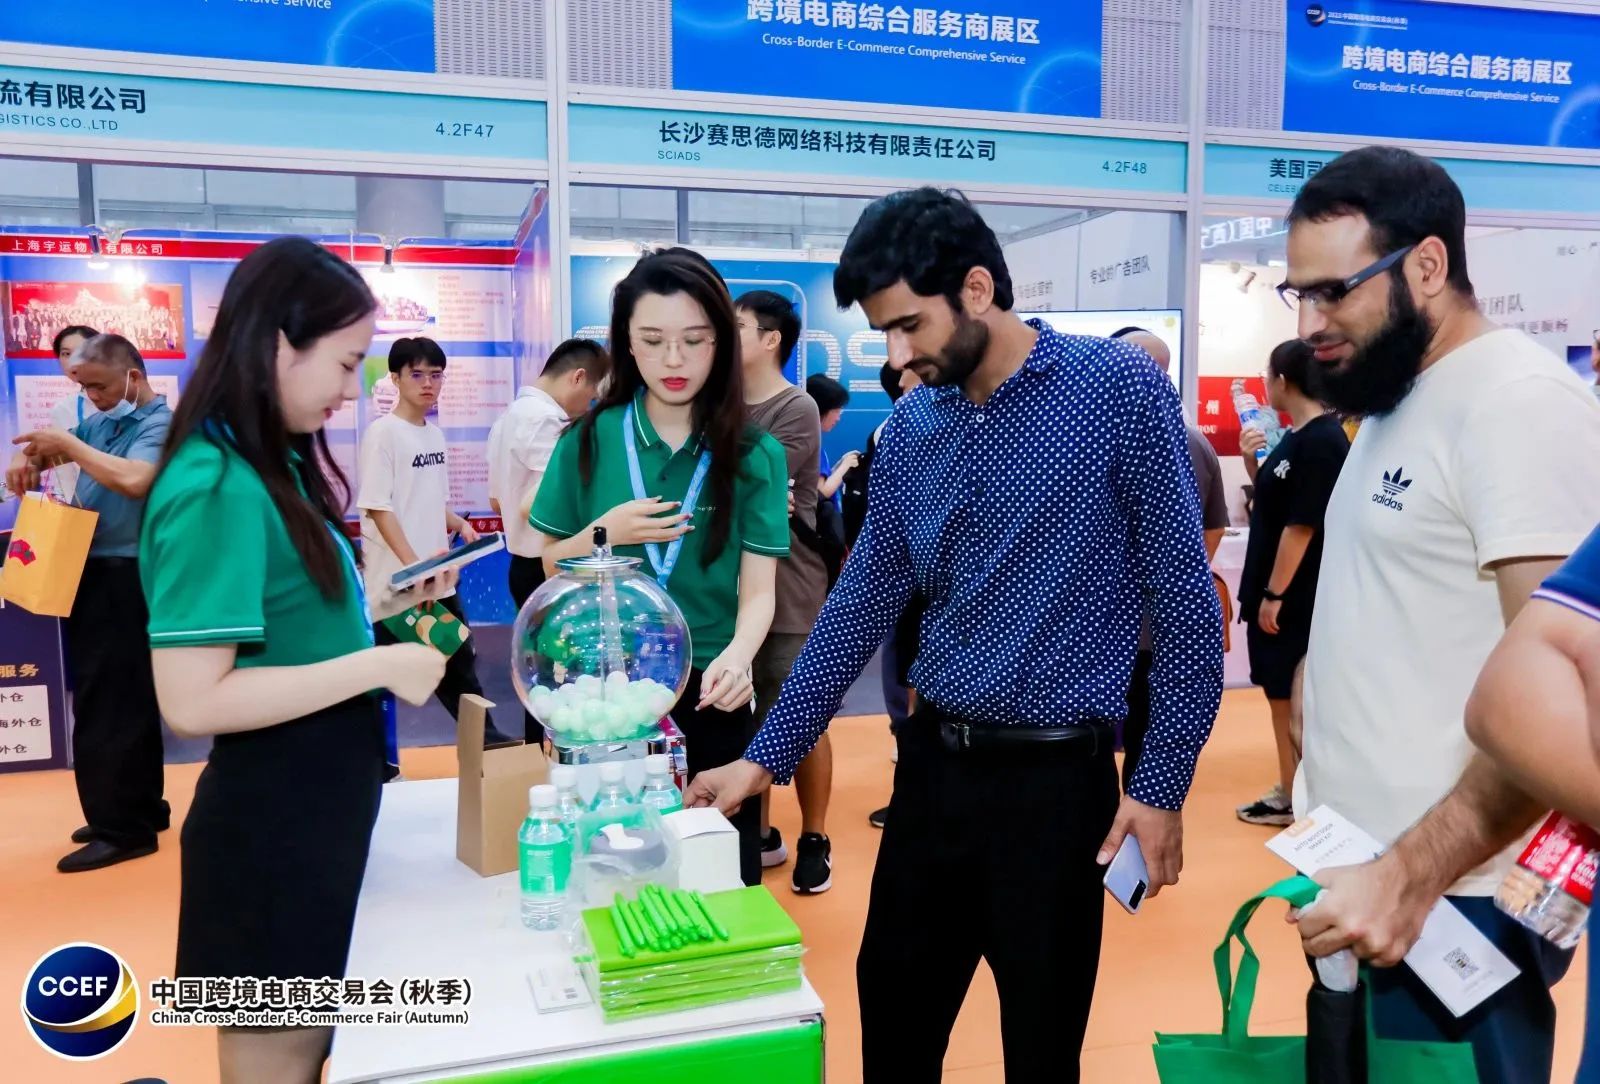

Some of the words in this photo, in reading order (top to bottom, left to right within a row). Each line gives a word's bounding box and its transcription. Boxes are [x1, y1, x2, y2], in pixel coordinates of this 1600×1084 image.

[747, 0, 1041, 45] 跨境电商综合服务商展区
[762, 33, 834, 49] Cross-Border
[837, 39, 905, 55] E-Commerce
[908, 45, 988, 62] Comprehensive
[989, 52, 1026, 65] Service
[1342, 45, 1572, 84] 跨境电商综合服务商展区
[1353, 80, 1408, 93] Cross-Border
[1410, 84, 1464, 97] E-Commerce
[1465, 88, 1529, 101] Comprehensive
[1530, 92, 1560, 104] Service
[435, 122, 494, 138] 4.2F47
[659, 120, 996, 161] 长沙赛思德网络科技有限责任公司
[657, 150, 701, 161] SCIADS
[1102, 161, 1147, 175] 4.2F48
[1269, 158, 1328, 179] 美国司
[12, 239, 164, 256] 上海宇运物有限公司
[1372, 493, 1403, 511] adidas
